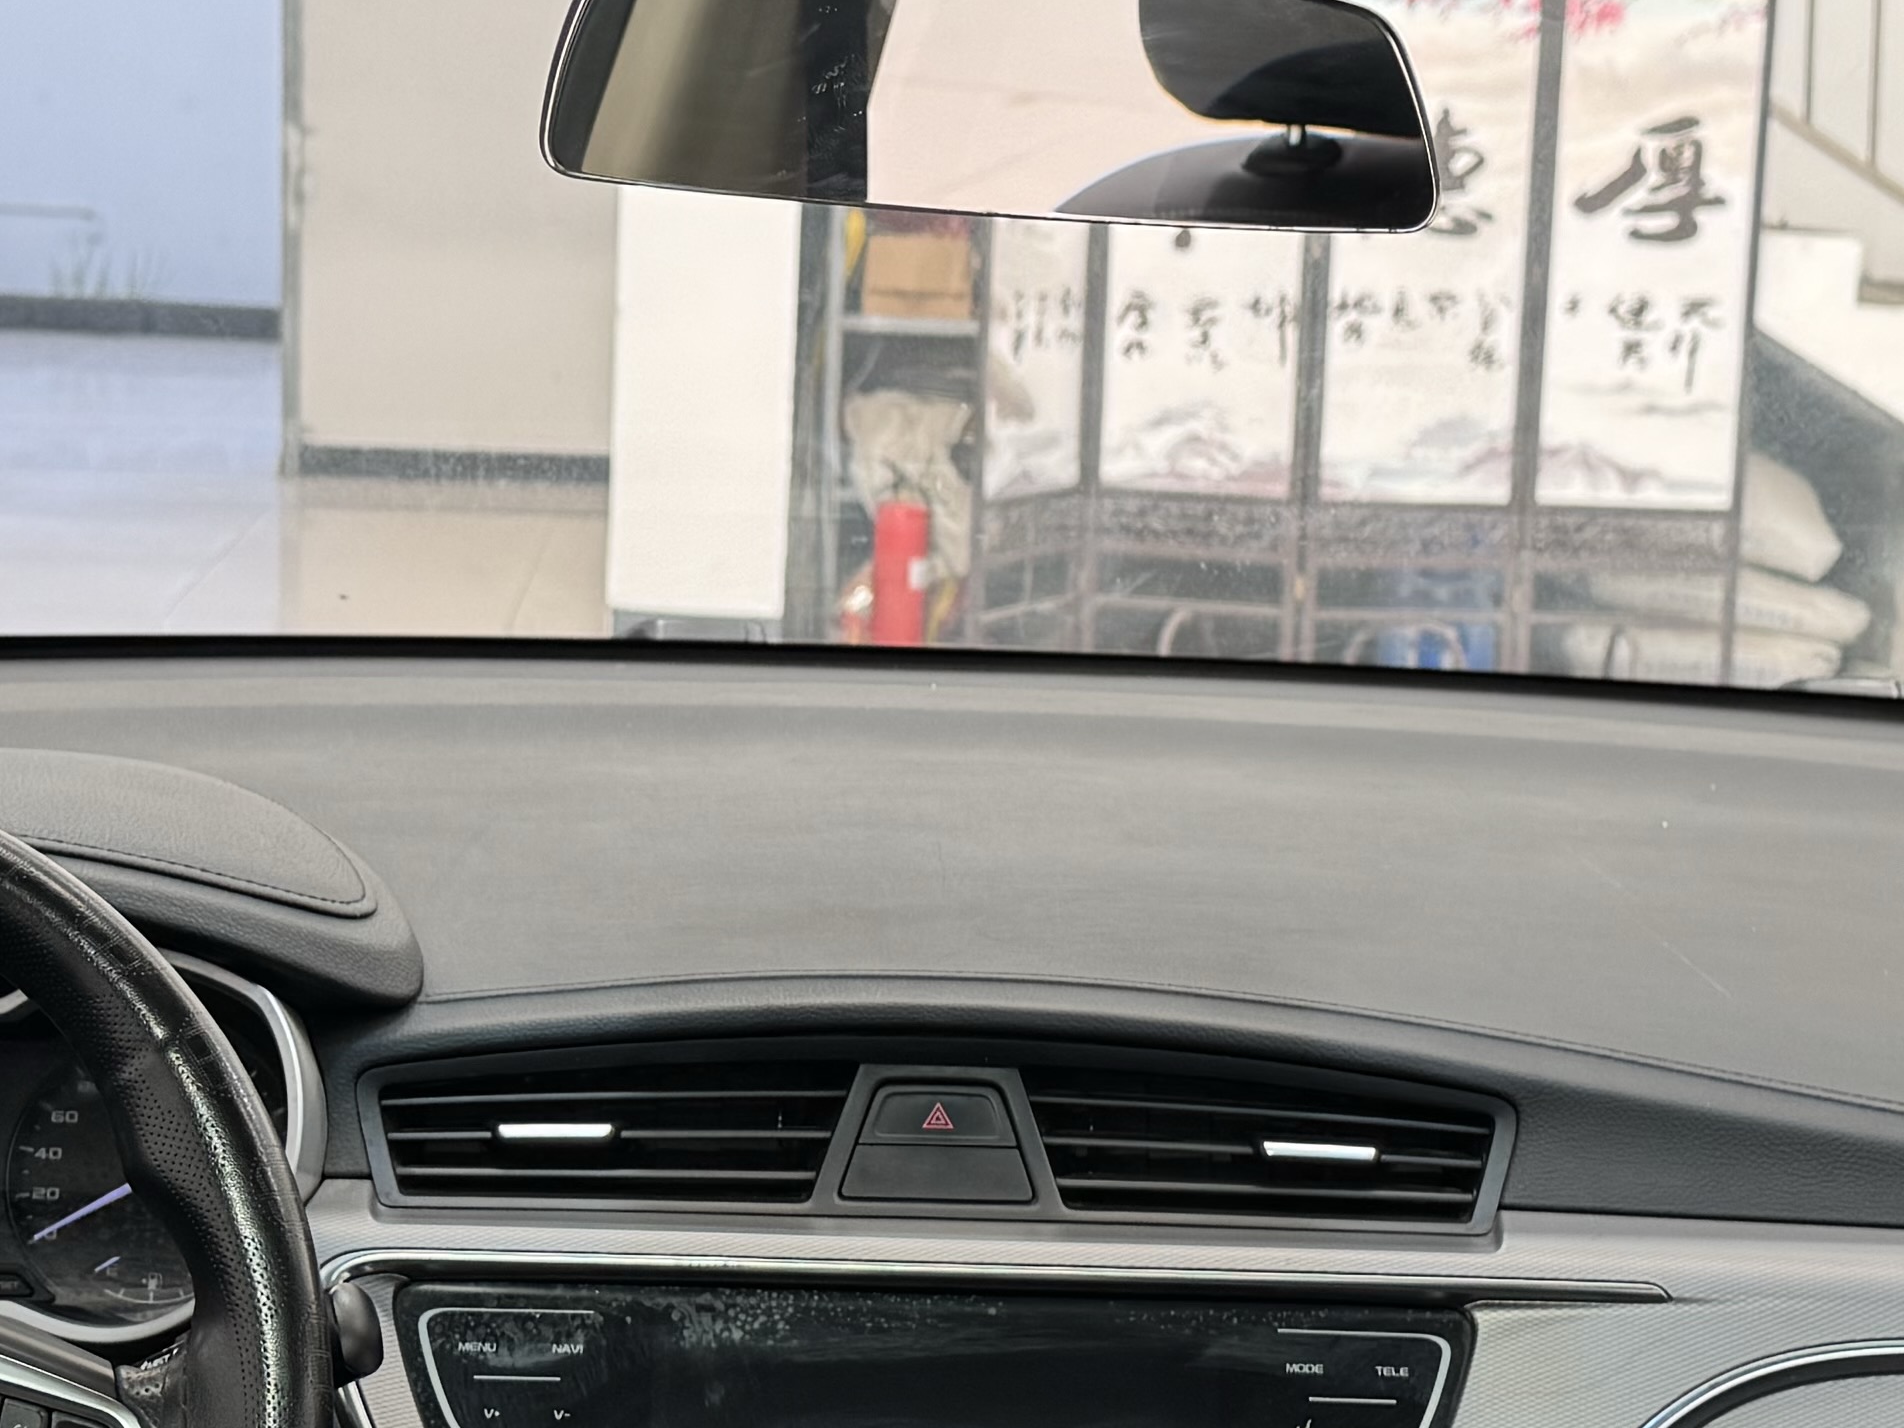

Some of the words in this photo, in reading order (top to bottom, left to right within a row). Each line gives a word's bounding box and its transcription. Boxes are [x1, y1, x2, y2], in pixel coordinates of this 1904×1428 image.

[1572, 115, 1727, 242] 厚
[50, 1110, 79, 1123] 60
[33, 1147, 63, 1160] 40
[32, 1187, 60, 1201] 20
[457, 1341, 497, 1353] MENU
[551, 1343, 584, 1355] NAVI
[1285, 1362, 1324, 1374] MODE
[1374, 1365, 1409, 1377] TELE
